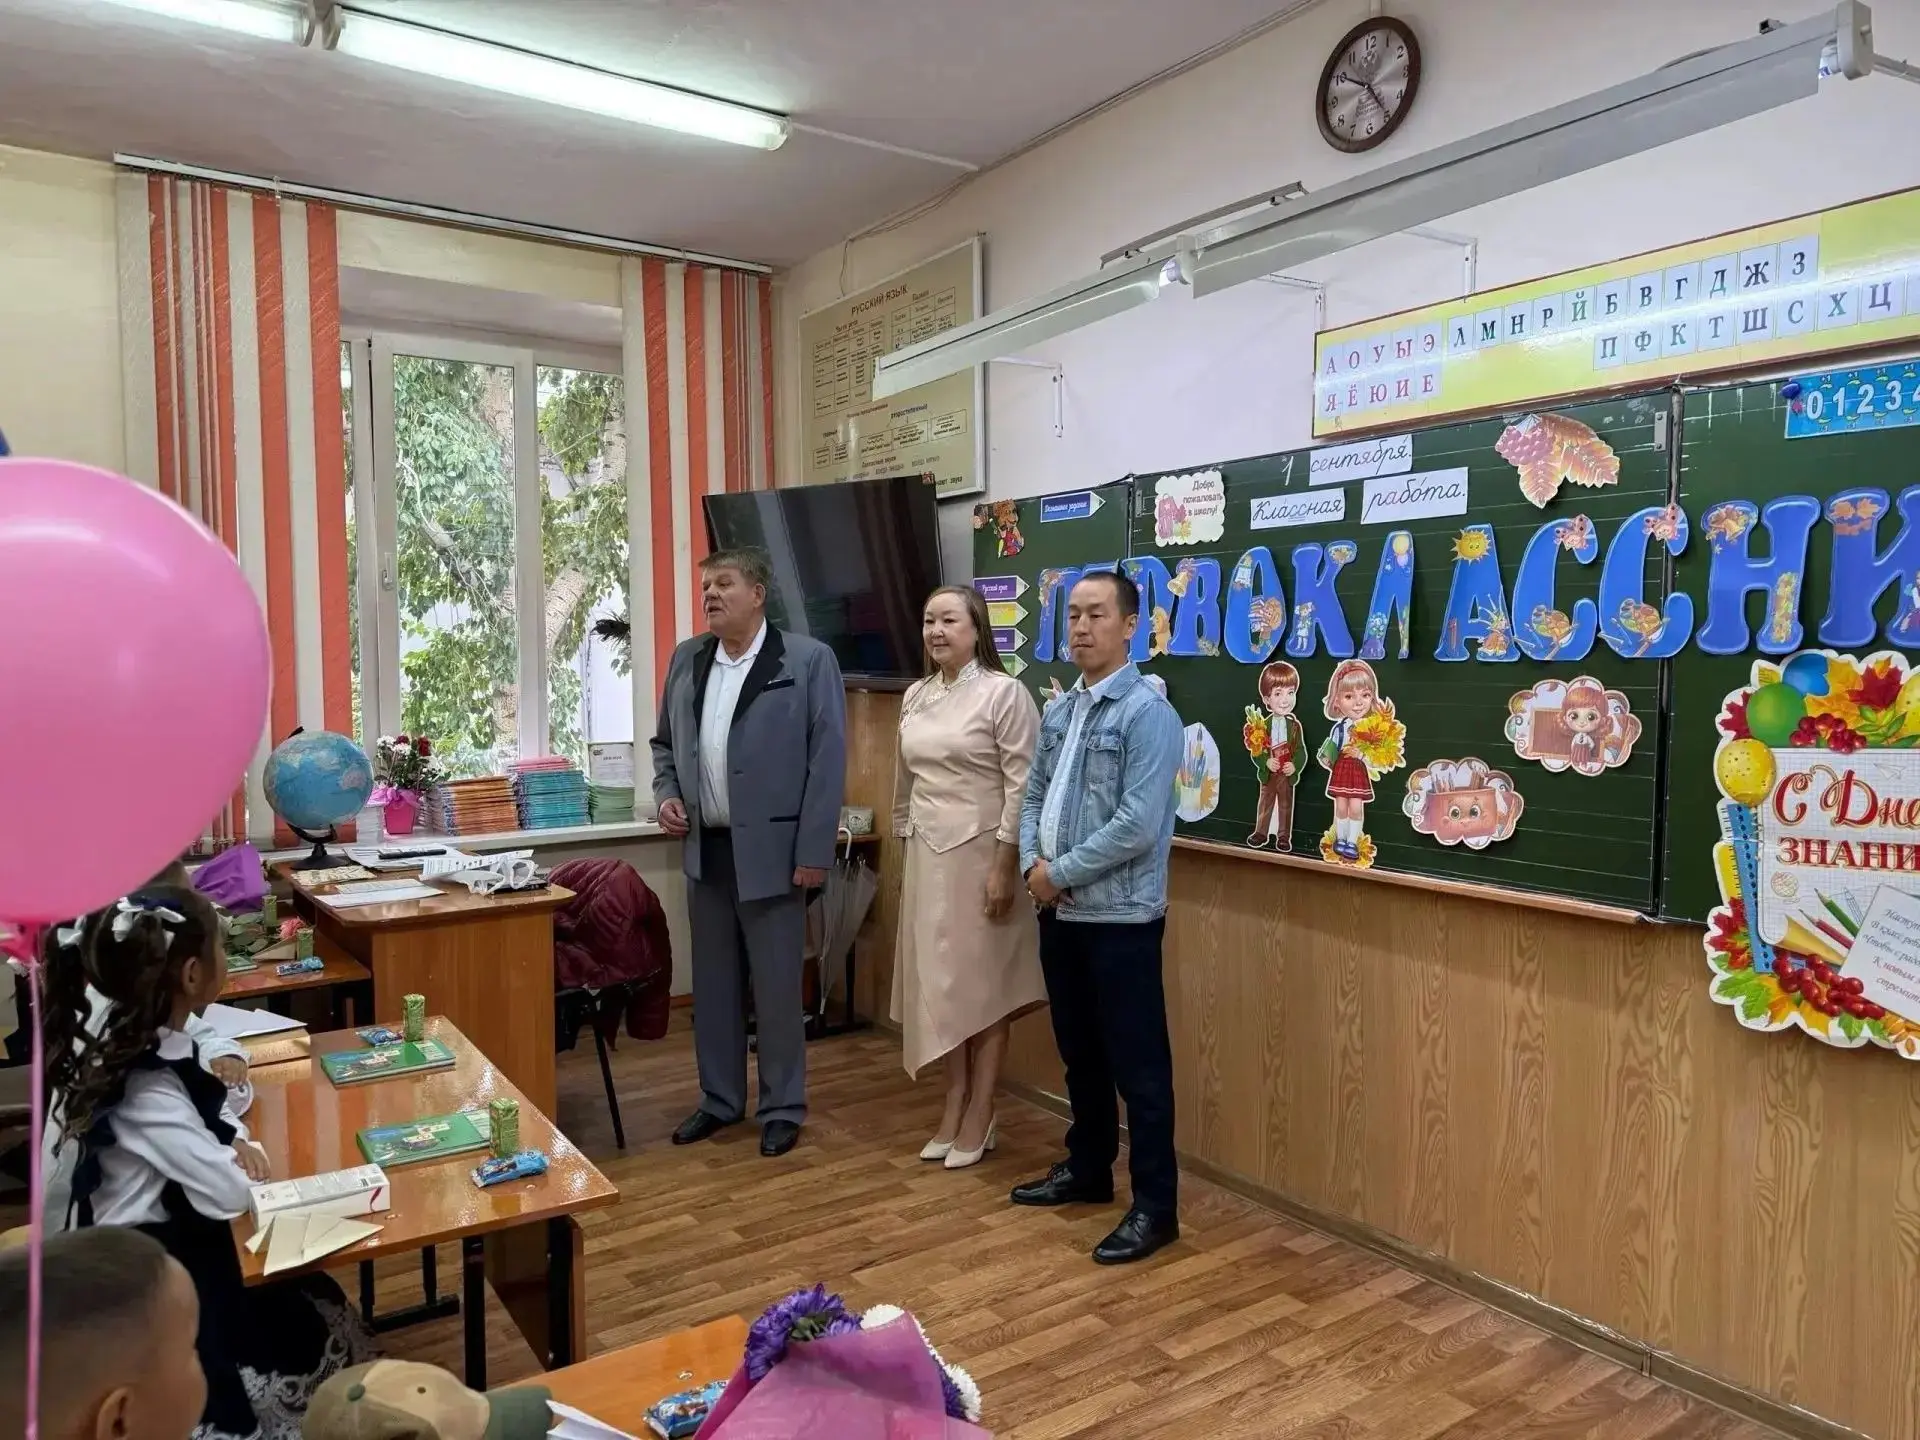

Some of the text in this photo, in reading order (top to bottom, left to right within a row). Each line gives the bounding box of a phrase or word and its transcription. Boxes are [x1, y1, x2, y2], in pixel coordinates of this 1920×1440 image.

[1365, 35, 1377, 50] 12
[1397, 45, 1404, 59] 2
[1334, 72, 1347, 86] 10
[1337, 115, 1345, 127] 8
[1384, 110, 1391, 123] 5
[1350, 124, 1357, 137] 7
[1366, 123, 1373, 135] 6
[851, 293, 885, 316] РУССКИЙ
[886, 284, 909, 301] ЯЗЫК
[1327, 252, 1806, 375] А О У Ы Э Л М Н Р Й Б В Г Д Ж З
[1600, 281, 1892, 359] П Ф К Т Ш С Х Ц
[1325, 374, 1434, 412] Я Ё Ю И Е
[1806, 391, 1823, 420] 0
[1833, 387, 1846, 417] 1
[1857, 383, 1875, 414] 2
[1885, 380, 1902, 411] 3
[1282, 456, 1294, 486] 1
[1192, 480, 1215, 491] Добро
[1183, 493, 1223, 504] пожаловать
[1194, 505, 1218, 516] школу!
